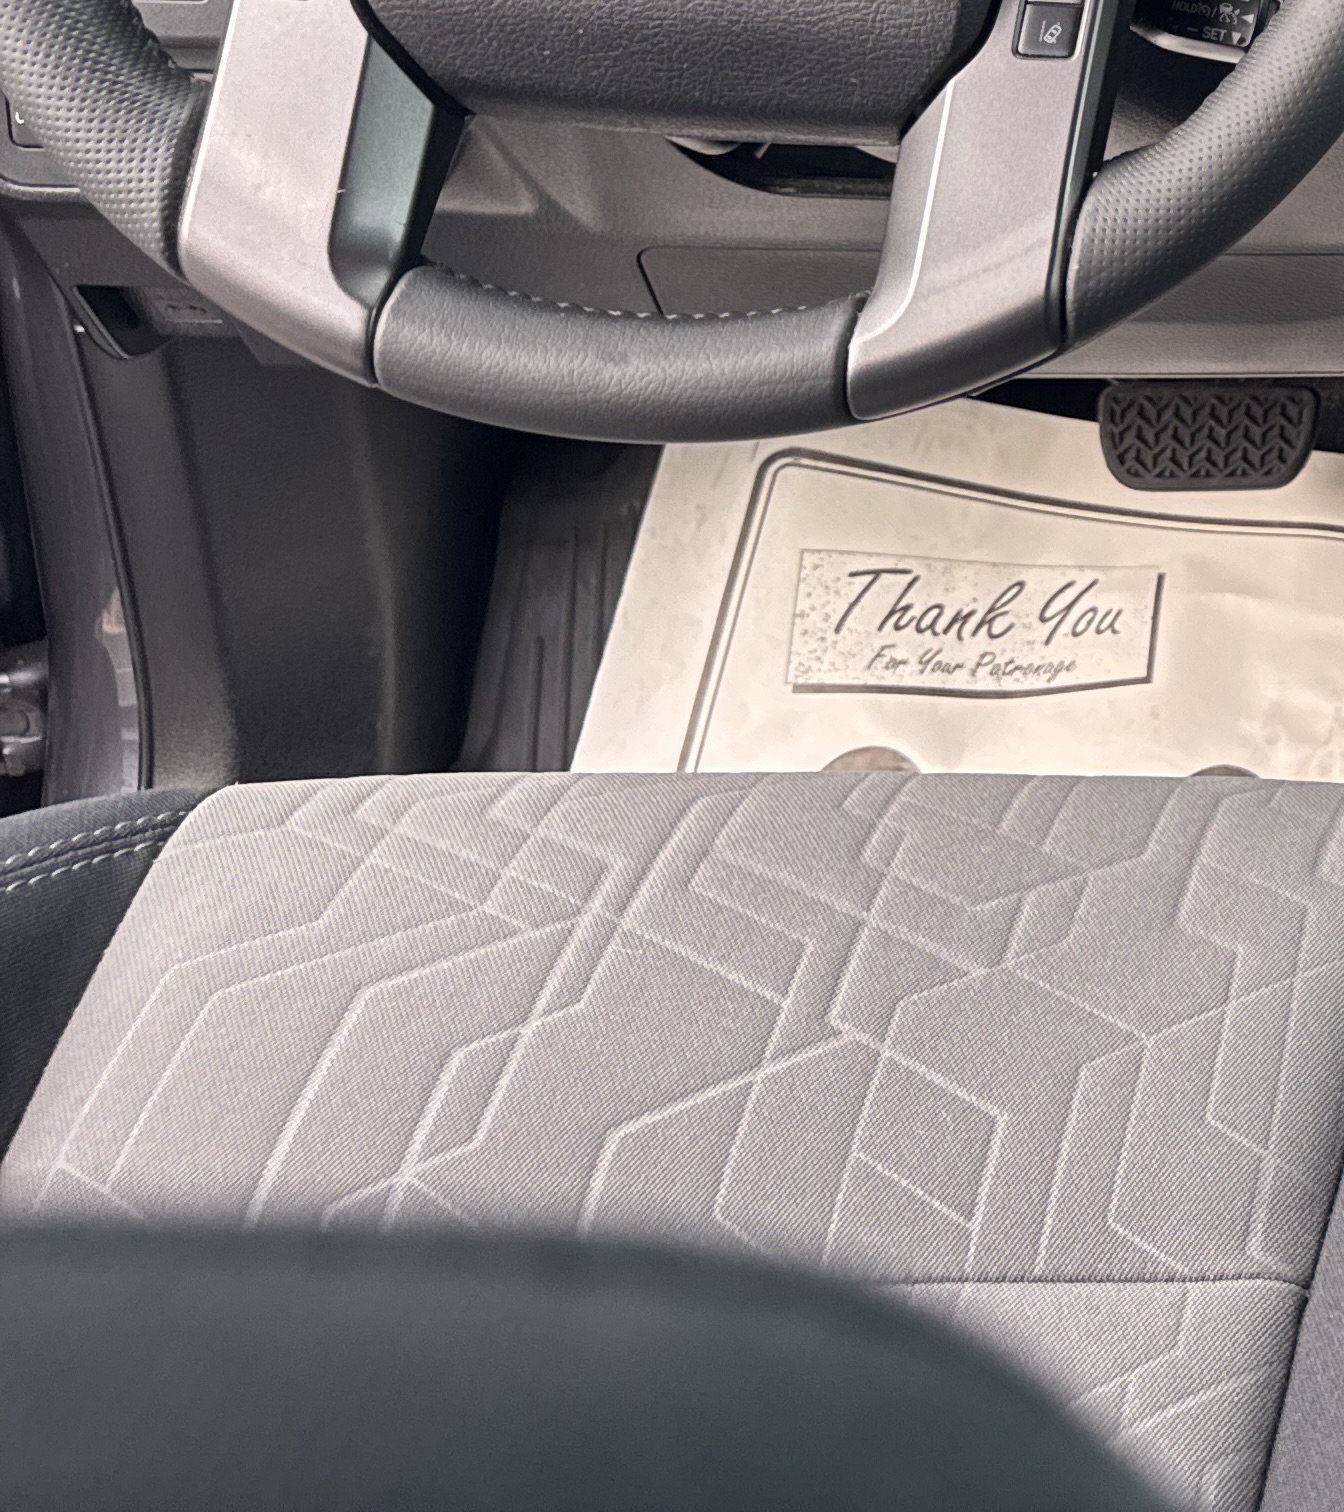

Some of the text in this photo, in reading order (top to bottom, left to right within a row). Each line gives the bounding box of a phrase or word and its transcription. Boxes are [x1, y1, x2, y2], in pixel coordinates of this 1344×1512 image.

[1202, 27, 1227, 41] SET
[834, 568, 1123, 646] Thank You
[867, 644, 1077, 683] For Your Patronage
